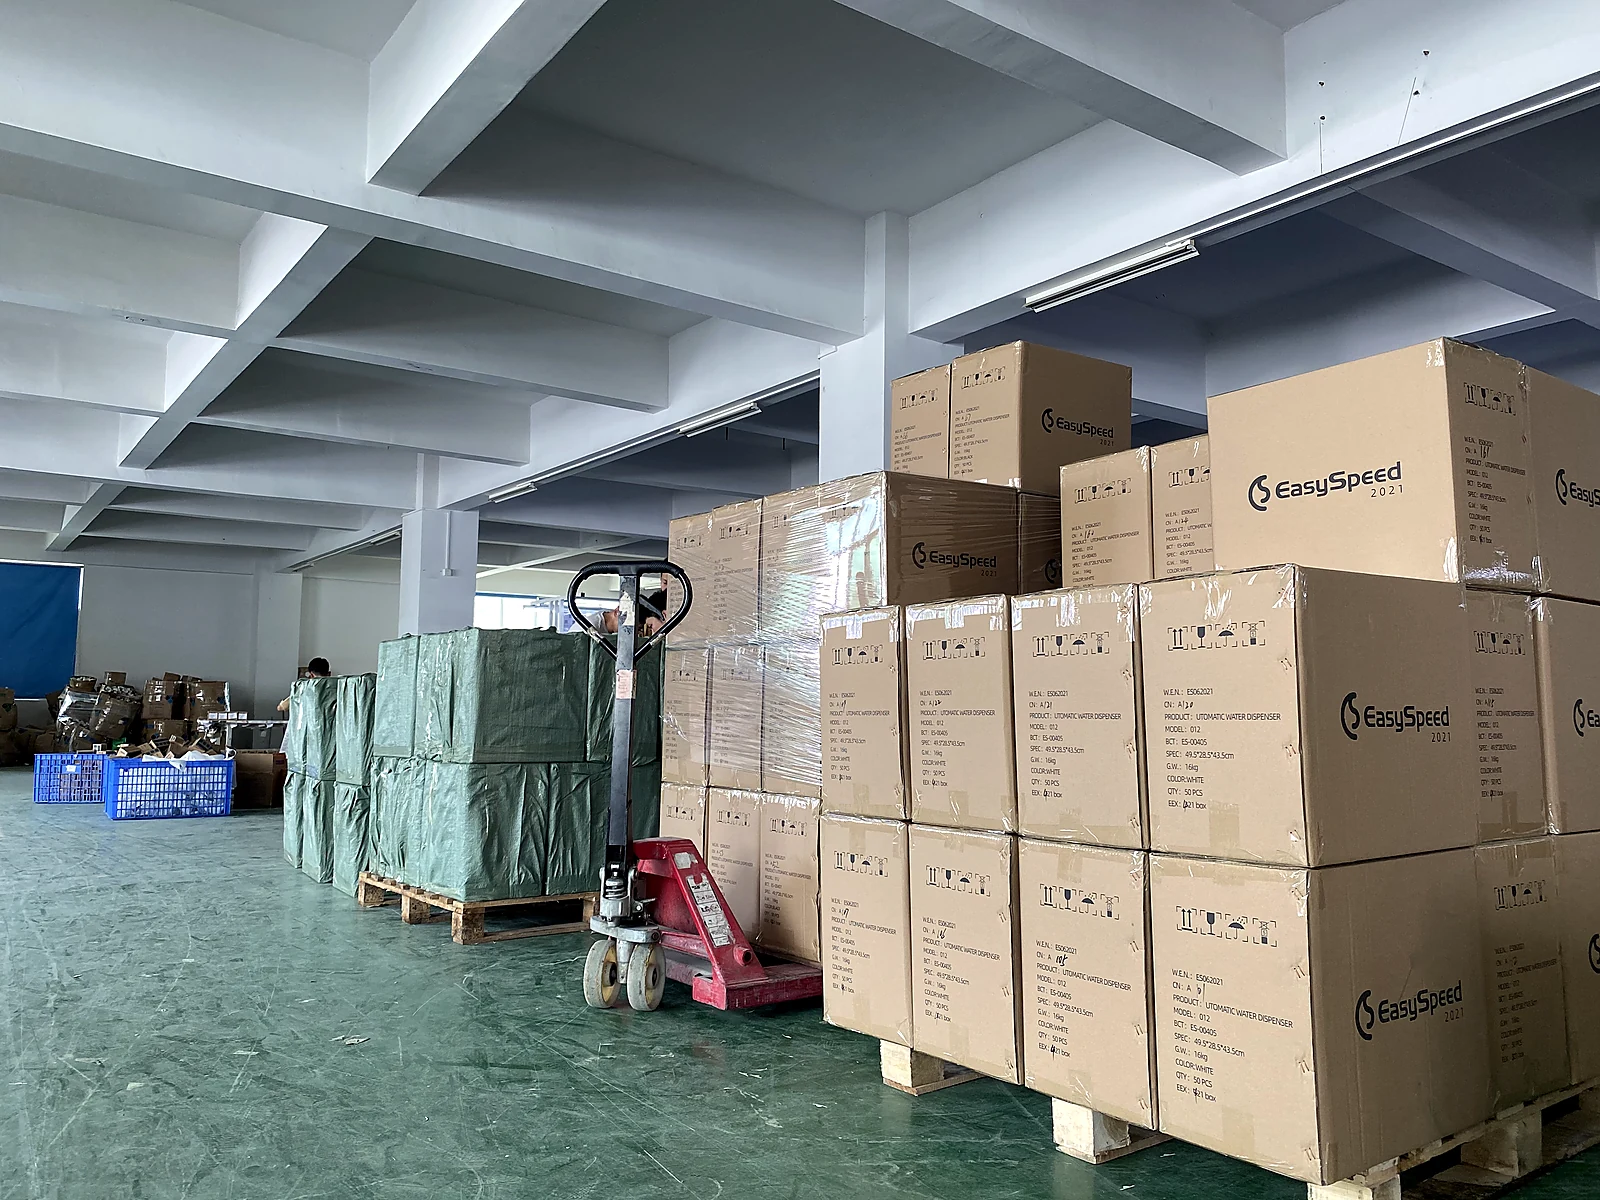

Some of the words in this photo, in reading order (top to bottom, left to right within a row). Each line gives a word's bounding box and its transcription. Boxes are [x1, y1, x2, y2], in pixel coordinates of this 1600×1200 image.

[1057, 417, 1113, 438] EasySpeed
[1275, 461, 1401, 498] EasySpeed
[1371, 485, 1403, 497] 2021
[930, 551, 996, 569] EasySpeed
[1364, 706, 1449, 732] EasySpeed
[1432, 732, 1450, 742] 2021
[1185, 764, 1198, 772] 16kg
[1063, 969, 1086, 980] UTOMATIC
[1087, 975, 1103, 984] WATER
[1104, 979, 1131, 991] DISPENSER
[1196, 974, 1223, 985] ES062021
[1378, 980, 1462, 1023] EasySpeed
[1199, 1013, 1211, 1022] 012
[1205, 1002, 1235, 1015] UTOMATIC
[1236, 1009, 1257, 1020] WATER
[1258, 1014, 1293, 1028] DISPENSER
[1445, 1008, 1463, 1022] 2021
[1190, 1024, 1217, 1036] ES-00405
[1194, 1051, 1208, 1062] 16kg
[1194, 1076, 1201, 1084] 50
[1202, 1079, 1212, 1088] PCS
[1205, 1091, 1216, 1102] box
